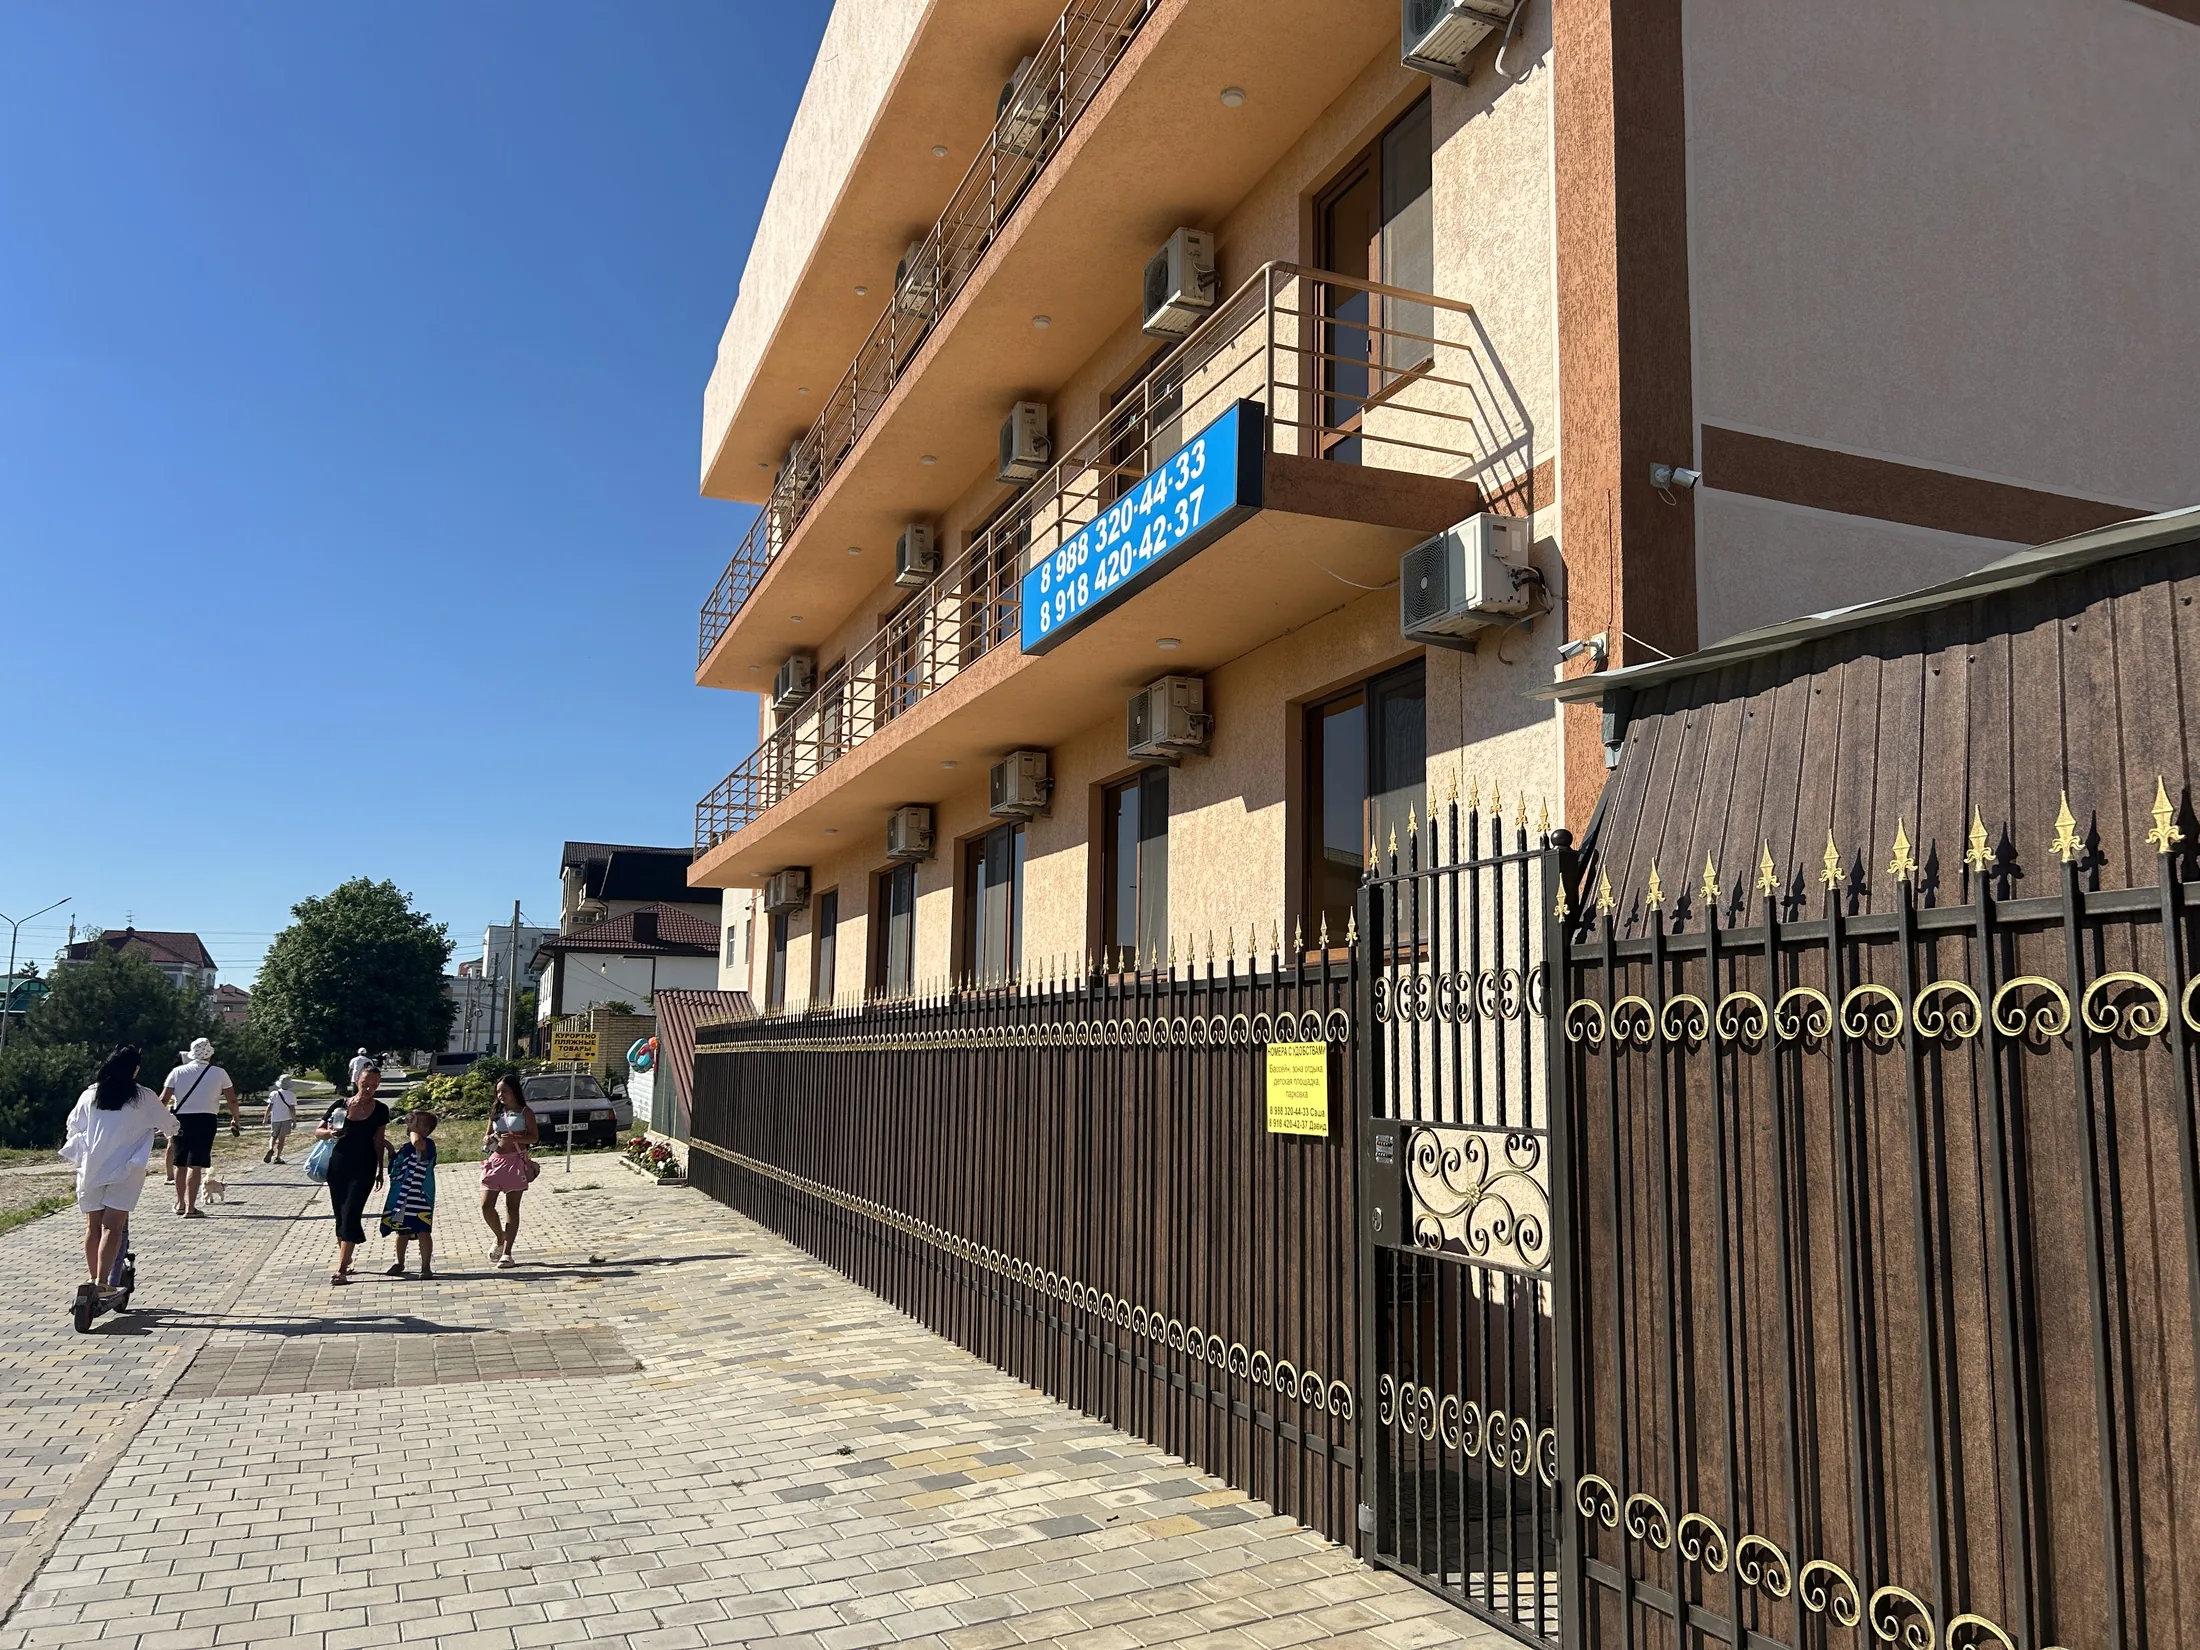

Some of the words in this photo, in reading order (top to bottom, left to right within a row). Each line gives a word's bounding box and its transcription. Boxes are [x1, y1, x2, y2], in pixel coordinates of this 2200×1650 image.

[1040, 562, 1051, 594] 8
[1055, 532, 1089, 582] 988
[1040, 600, 1051, 633] 8
[1055, 572, 1089, 622] 918
[1283, 1118, 1308, 1130] 420-42-37
[1284, 1106, 1309, 1117] 320-44-33
